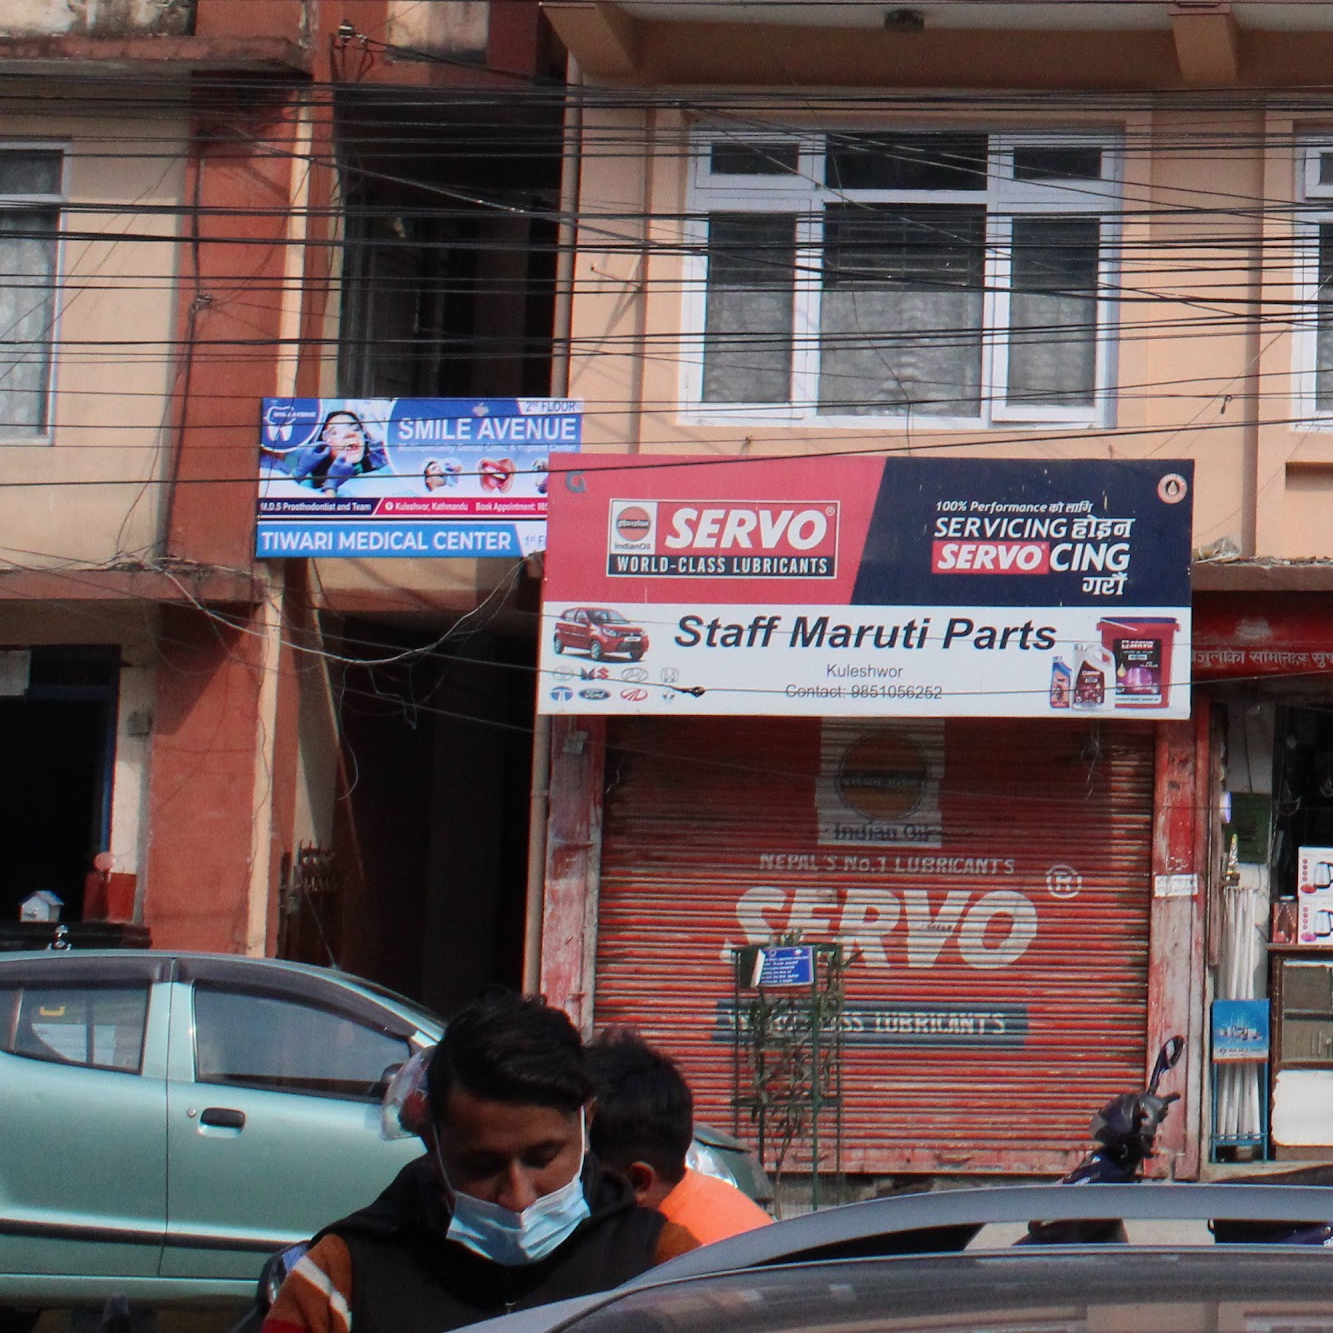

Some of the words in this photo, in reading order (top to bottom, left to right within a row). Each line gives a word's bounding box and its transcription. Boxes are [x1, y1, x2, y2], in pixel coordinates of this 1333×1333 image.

[397, 417, 473, 441] SMILE
[476, 418, 577, 441] AVENUE
[283, 502, 336, 512] Prosthodontist
[336, 502, 351, 512] and
[352, 502, 372, 512] Team
[432, 502, 469, 512] Kathmandu
[475, 502, 493, 512] Book
[936, 500, 967, 512] 100%
[970, 500, 1047, 514] Performance
[665, 507, 828, 551] SERVO
[934, 516, 1067, 539] SERVICING
[262, 531, 334, 550] TIWARI
[339, 531, 429, 550] MEDICAL
[432, 532, 512, 550] CENTER
[617, 555, 725, 574] WORLD-CLASS
[733, 556, 828, 575] LUBRICANTS
[937, 544, 1043, 571] SERVO
[1050, 542, 1131, 572] CING
[674, 614, 781, 649] Staff
[789, 615, 931, 650] Maruti
[942, 617, 1058, 651] Parts
[826, 663, 904, 678] Kuleshwor
[785, 684, 846, 699] Contact:
[850, 685, 943, 700] 9851056252
[834, 823, 897, 841] Indian
[759, 853, 838, 871] NEPAL'S
[895, 855, 1016, 875] LUBRICANTS
[720, 885, 1039, 969] SERVO
[874, 1012, 1006, 1035] LUBRICANTS
